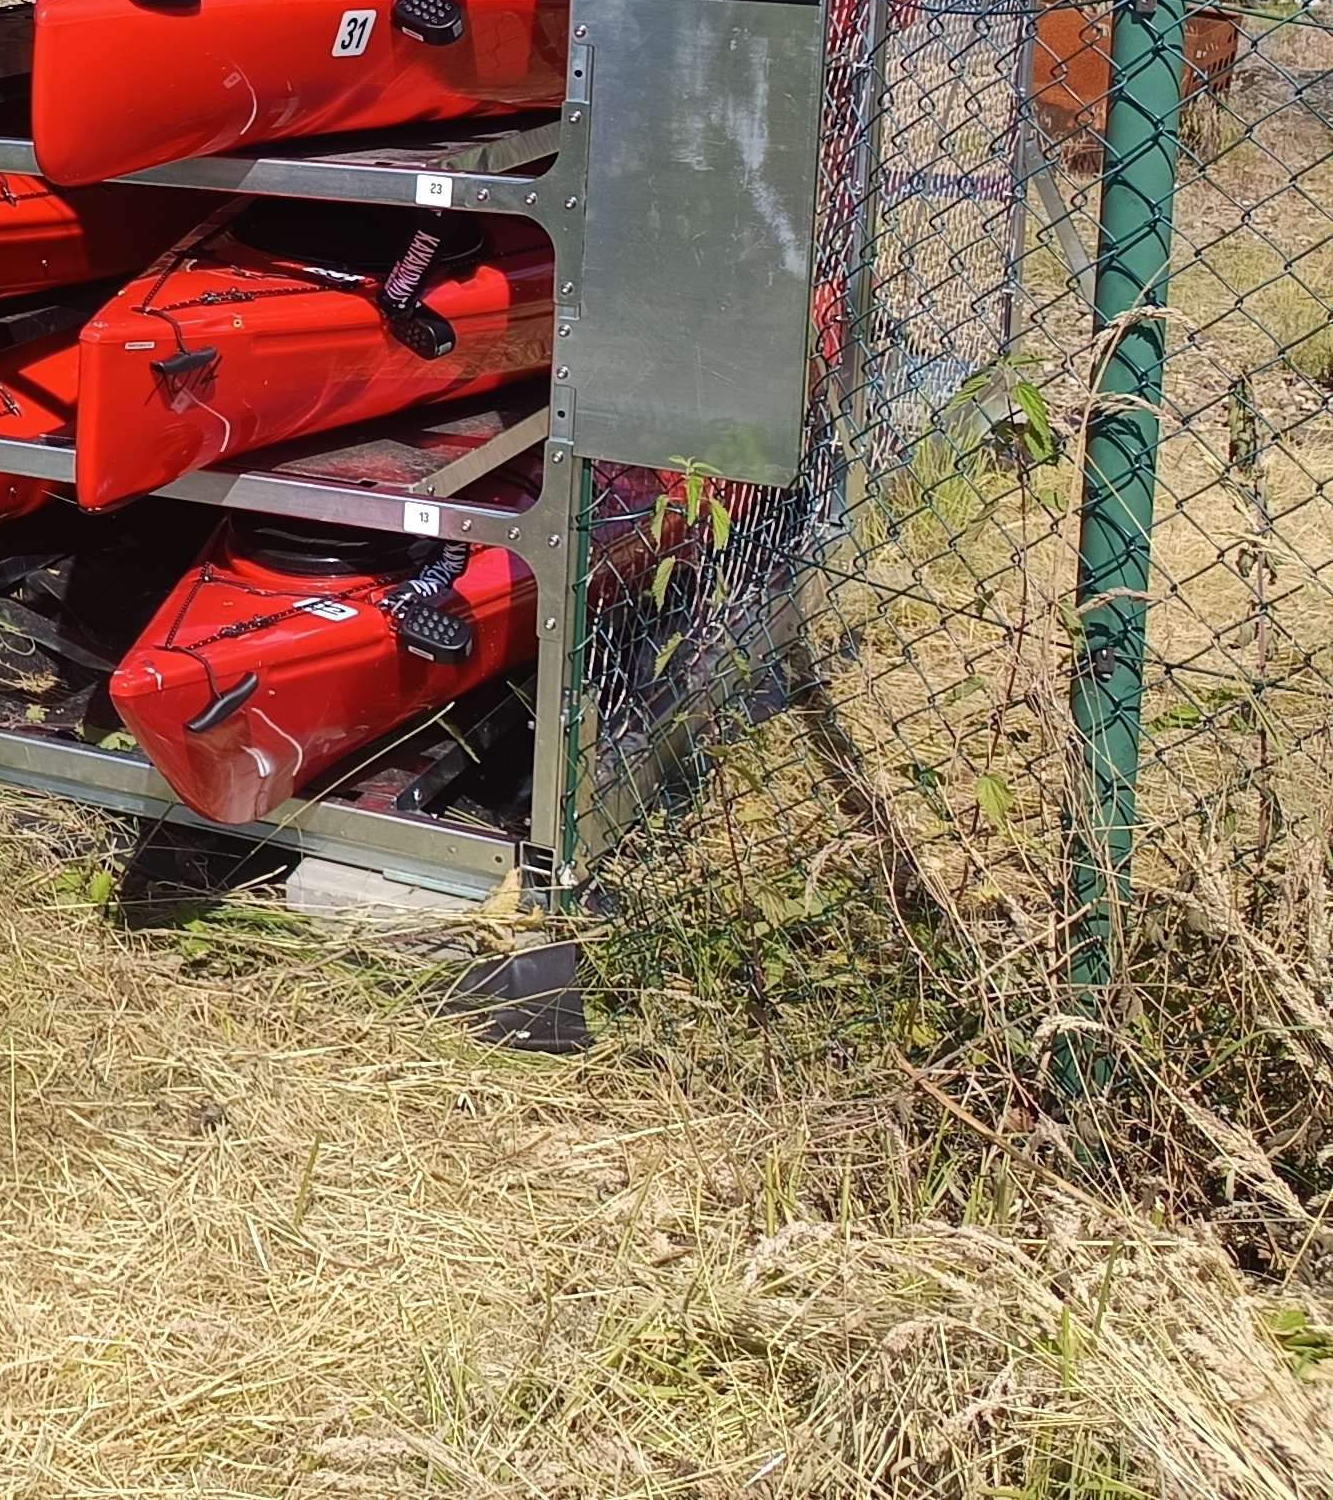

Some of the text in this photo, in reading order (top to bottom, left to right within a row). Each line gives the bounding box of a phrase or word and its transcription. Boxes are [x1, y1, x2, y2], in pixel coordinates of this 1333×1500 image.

[340, 16, 369, 50] 31
[430, 182, 443, 195] 23
[419, 511, 430, 523] 13
